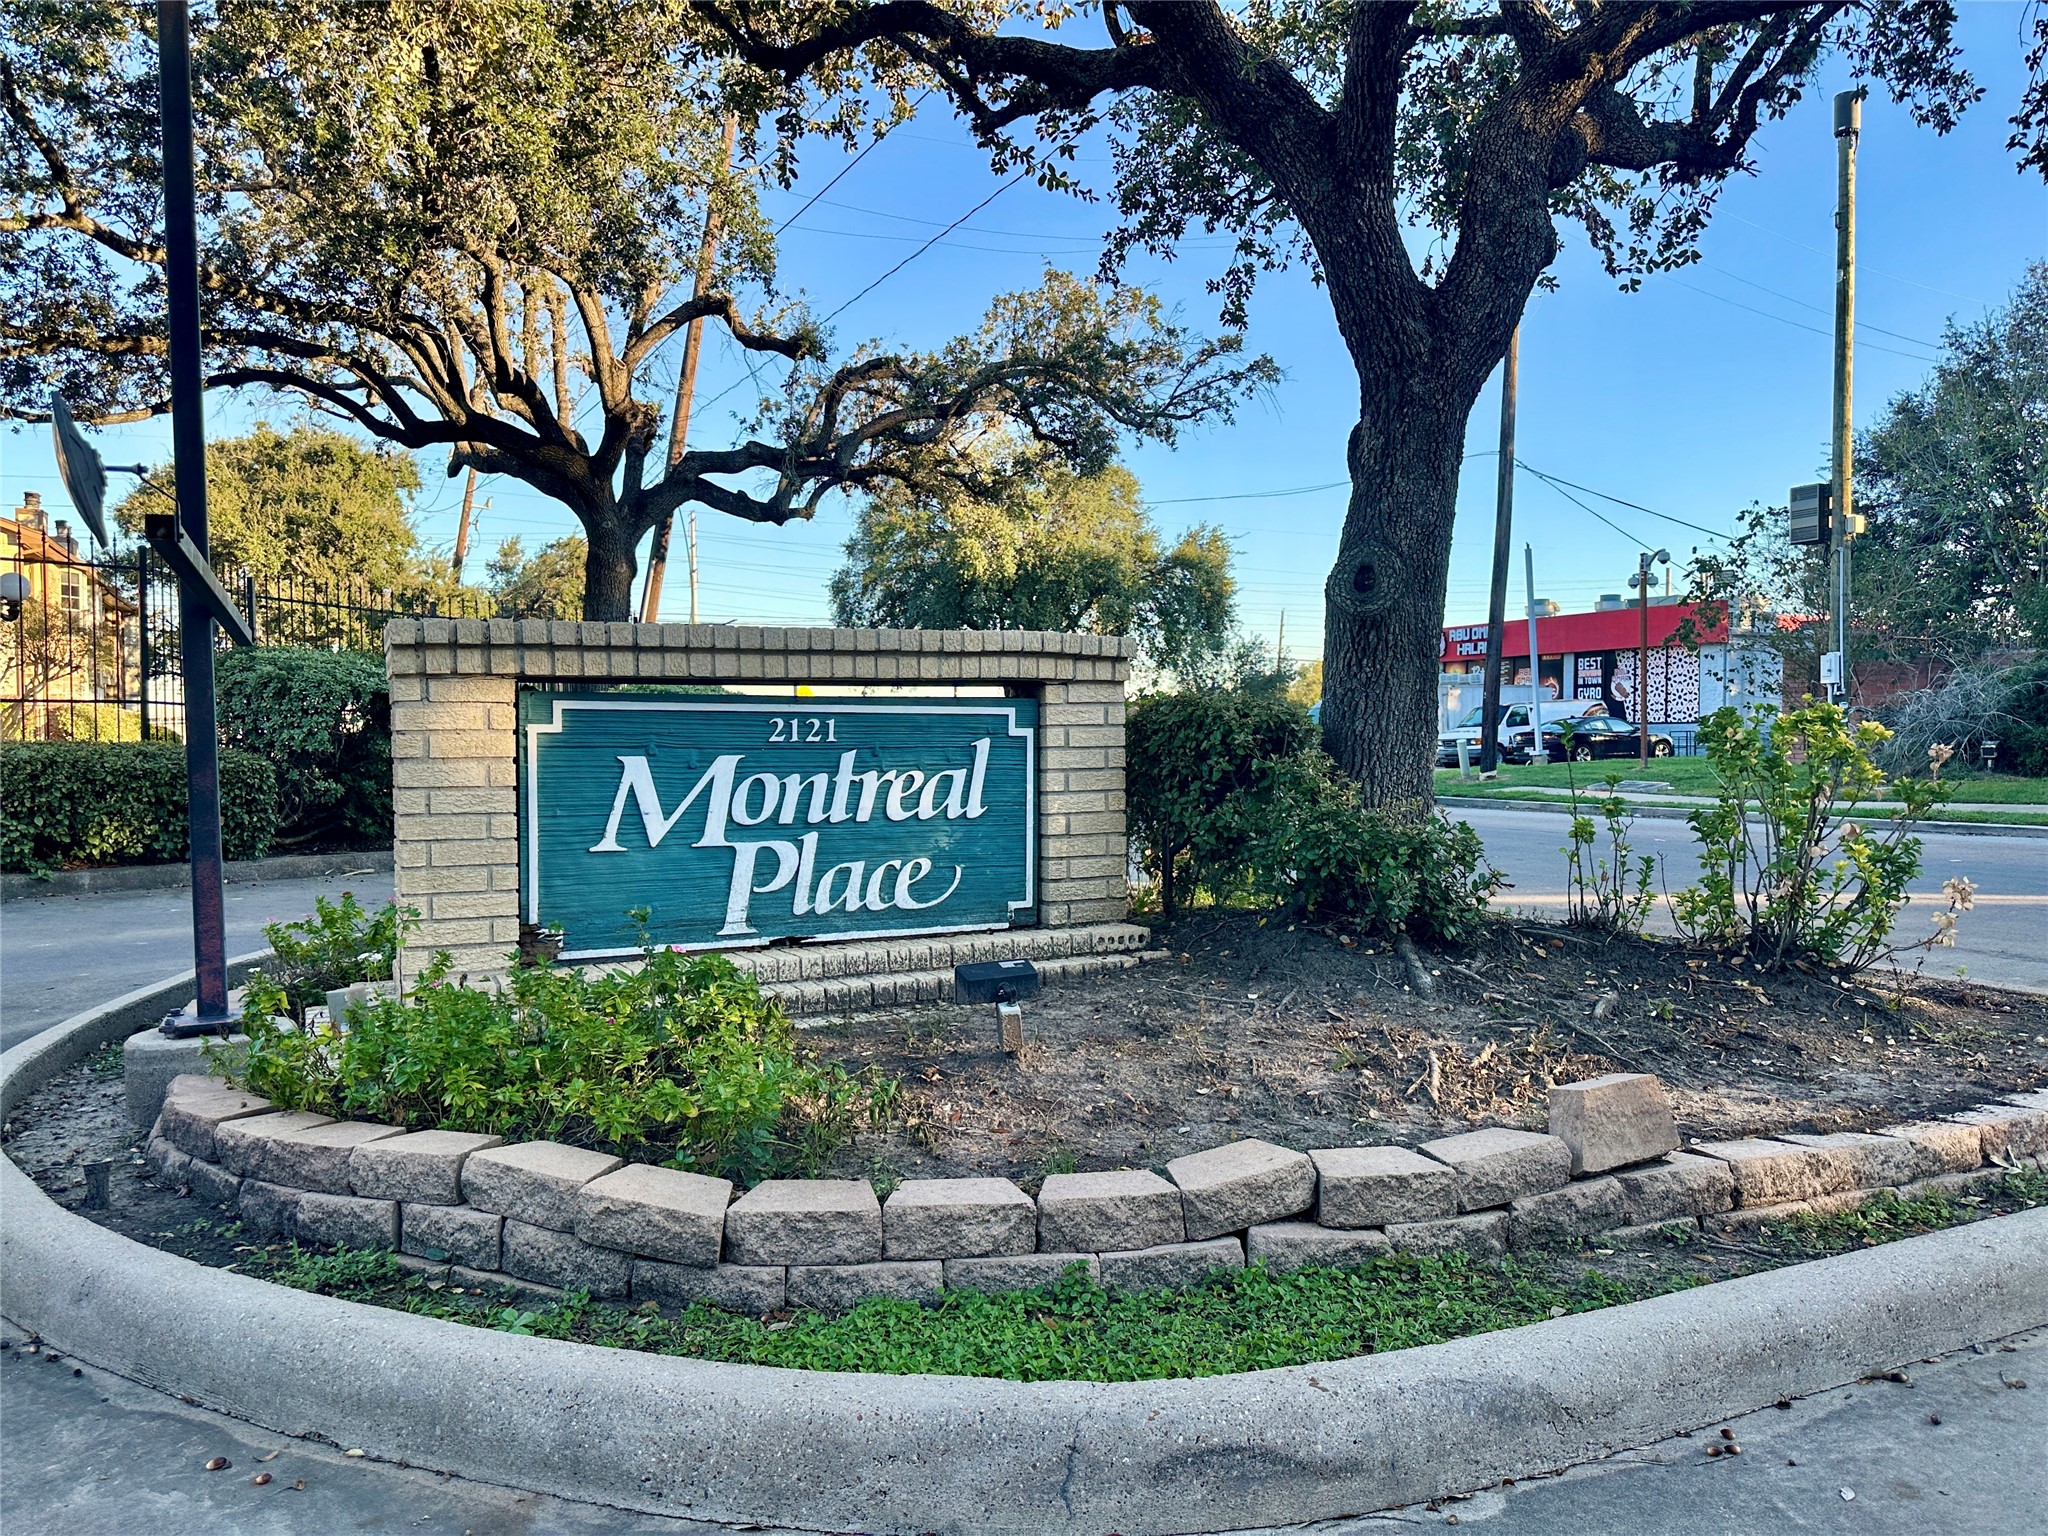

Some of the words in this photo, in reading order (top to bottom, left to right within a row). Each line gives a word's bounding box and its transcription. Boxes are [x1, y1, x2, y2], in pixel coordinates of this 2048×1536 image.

[1449, 628, 1470, 642] ABU
[1471, 625, 1489, 640] OM
[1578, 657, 1602, 670] BEST
[1585, 676, 1602, 685] TOWN
[1578, 687, 1602, 700] GYRO
[768, 717, 838, 743] 2121
[589, 737, 989, 853] Montreal
[716, 831, 962, 936] Place
